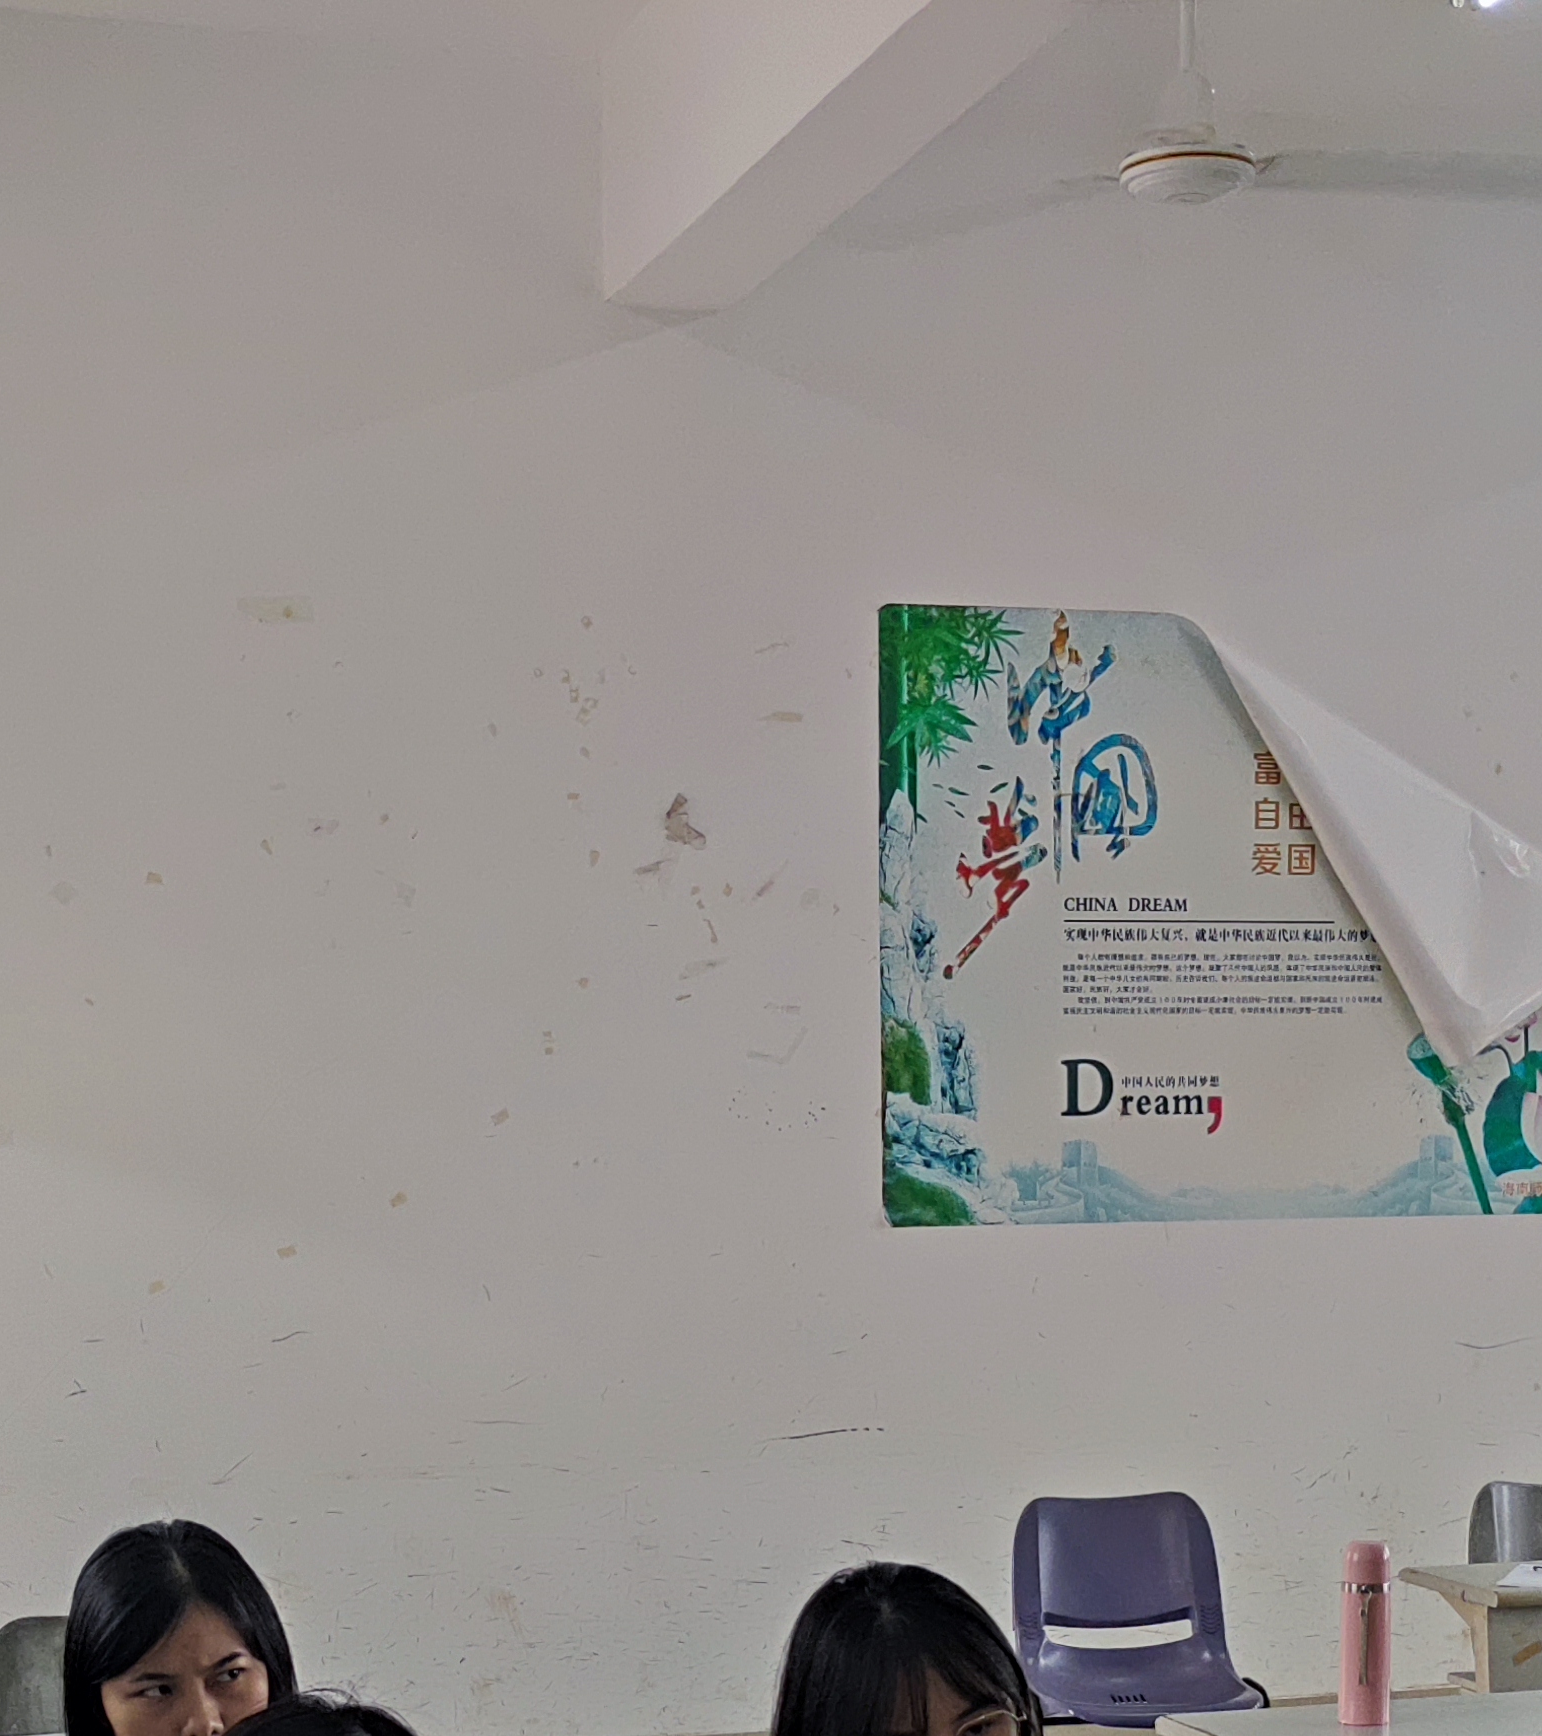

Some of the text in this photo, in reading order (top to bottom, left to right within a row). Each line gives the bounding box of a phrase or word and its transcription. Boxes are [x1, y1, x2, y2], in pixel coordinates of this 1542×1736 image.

[1252, 843, 1316, 876] 爱国
[1064, 897, 1188, 912] CHINA DREAM
[1122, 1075, 1220, 1088] 中国人民的共同梦想
